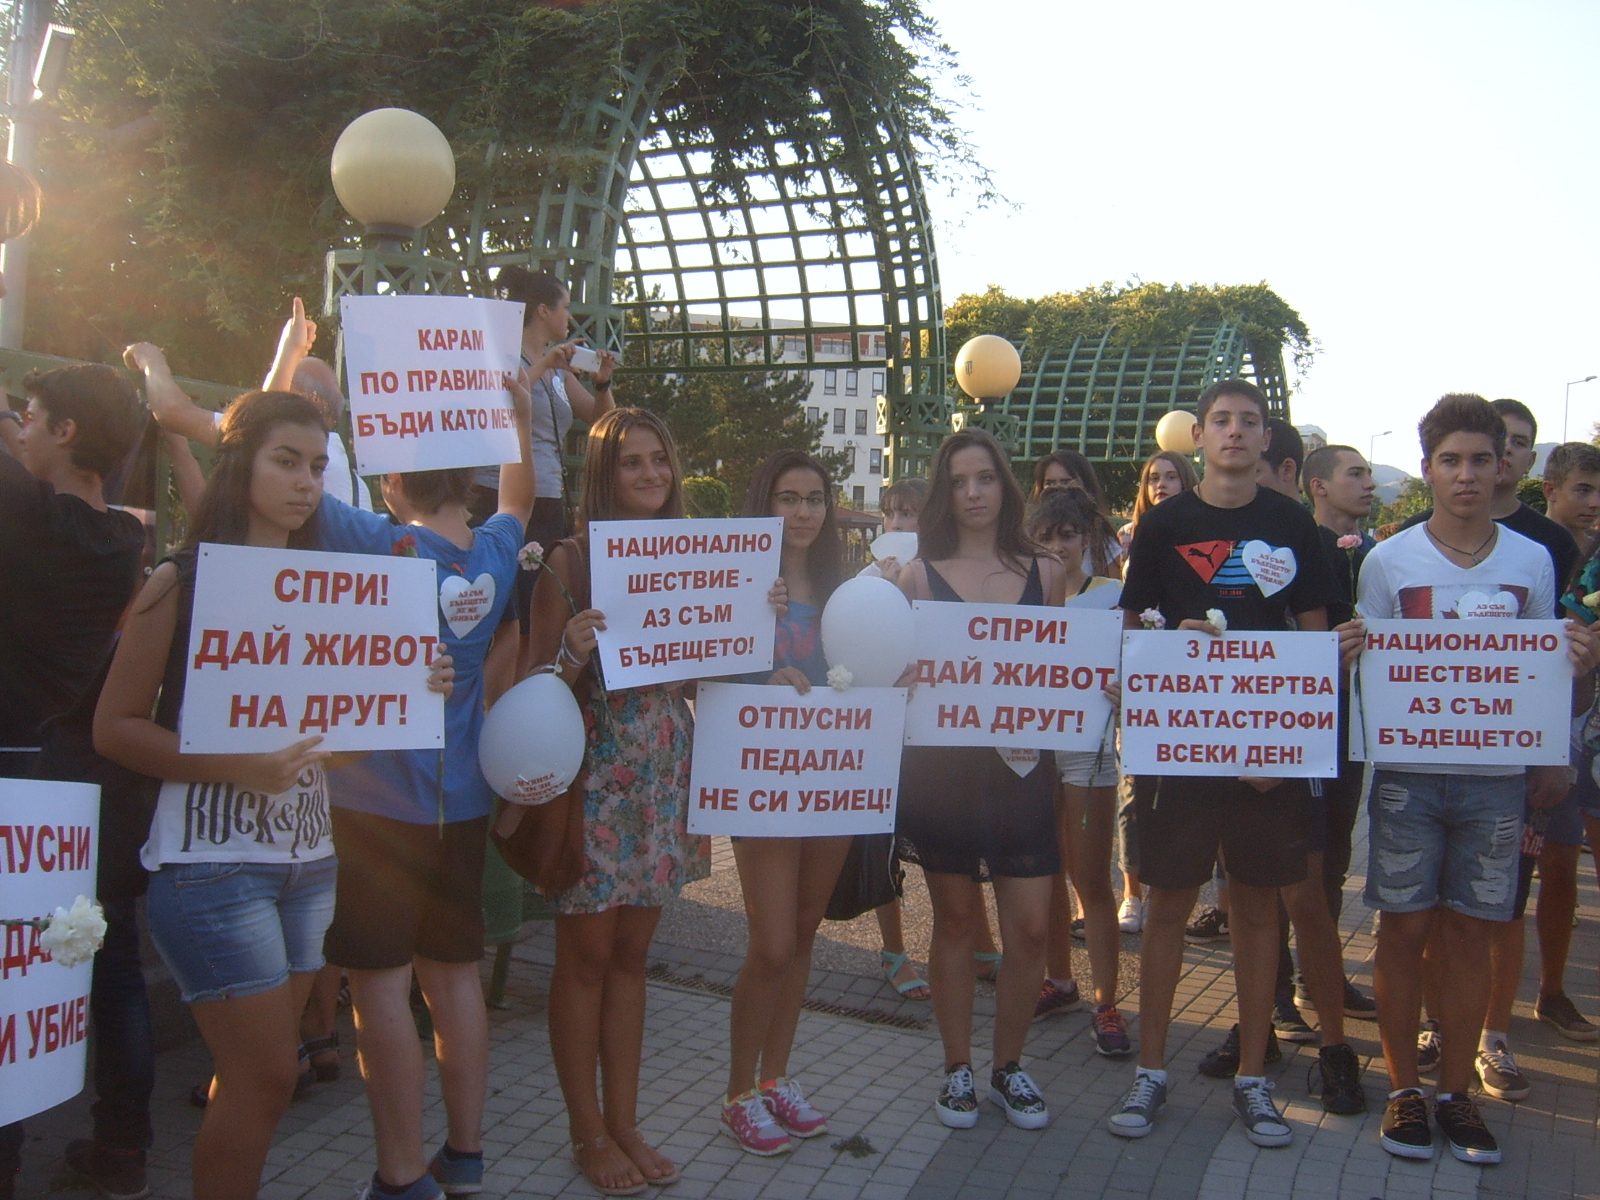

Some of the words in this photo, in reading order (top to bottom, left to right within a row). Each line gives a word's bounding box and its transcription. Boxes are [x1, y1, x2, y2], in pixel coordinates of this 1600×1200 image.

[417, 328, 484, 351] КАРАМ
[360, 371, 400, 395] ПО
[356, 410, 435, 439] БЪДИ
[440, 408, 488, 431] КАТО
[607, 533, 772, 559] НАЦИОНАЛНО
[274, 568, 389, 606] СПРИ!
[627, 569, 739, 594] ШЕСТВИЕ
[642, 608, 671, 628] АЗ
[678, 604, 732, 625] СЪМ
[968, 616, 1069, 645] СПРИ!
[1367, 633, 1559, 653] НАЦИОНАЛНО
[194, 624, 290, 671] ДАЙ
[302, 633, 438, 667] ЖИВОТ
[619, 637, 754, 667] БЪДЕЩЕТО!
[1186, 640, 1200, 658] 3
[1207, 640, 1276, 662] ДЕЦА
[914, 656, 982, 688] ДАЙ
[992, 661, 1116, 691] ЖИВОТ
[1127, 674, 1224, 693] СТАВАТ
[1231, 675, 1334, 695] ЖЕРТВА
[1388, 665, 1519, 684] ШЕСТВИЕ
[229, 694, 288, 727] НА
[299, 694, 407, 734] ДРУГ!
[738, 705, 872, 730] ОТПУСНИ
[1408, 698, 1442, 715] АЗ
[1450, 697, 1514, 716] СЪМ
[937, 705, 982, 729] НА
[990, 706, 1085, 734] ДРУГ!
[1126, 709, 1160, 727] НА
[1168, 709, 1334, 730] КАТАСТРОФИ
[1378, 728, 1543, 749] БЪДЕЩЕТО!
[740, 748, 864, 775] ПЕДАЛА!
[1157, 744, 1237, 763] ВСЕКИ
[1244, 745, 1303, 767] ДЕН!
[698, 787, 739, 812] НЕ
[748, 789, 788, 813] СИ
[797, 787, 893, 814] УБИЕЦ!
[0, 916, 53, 980] ДА
